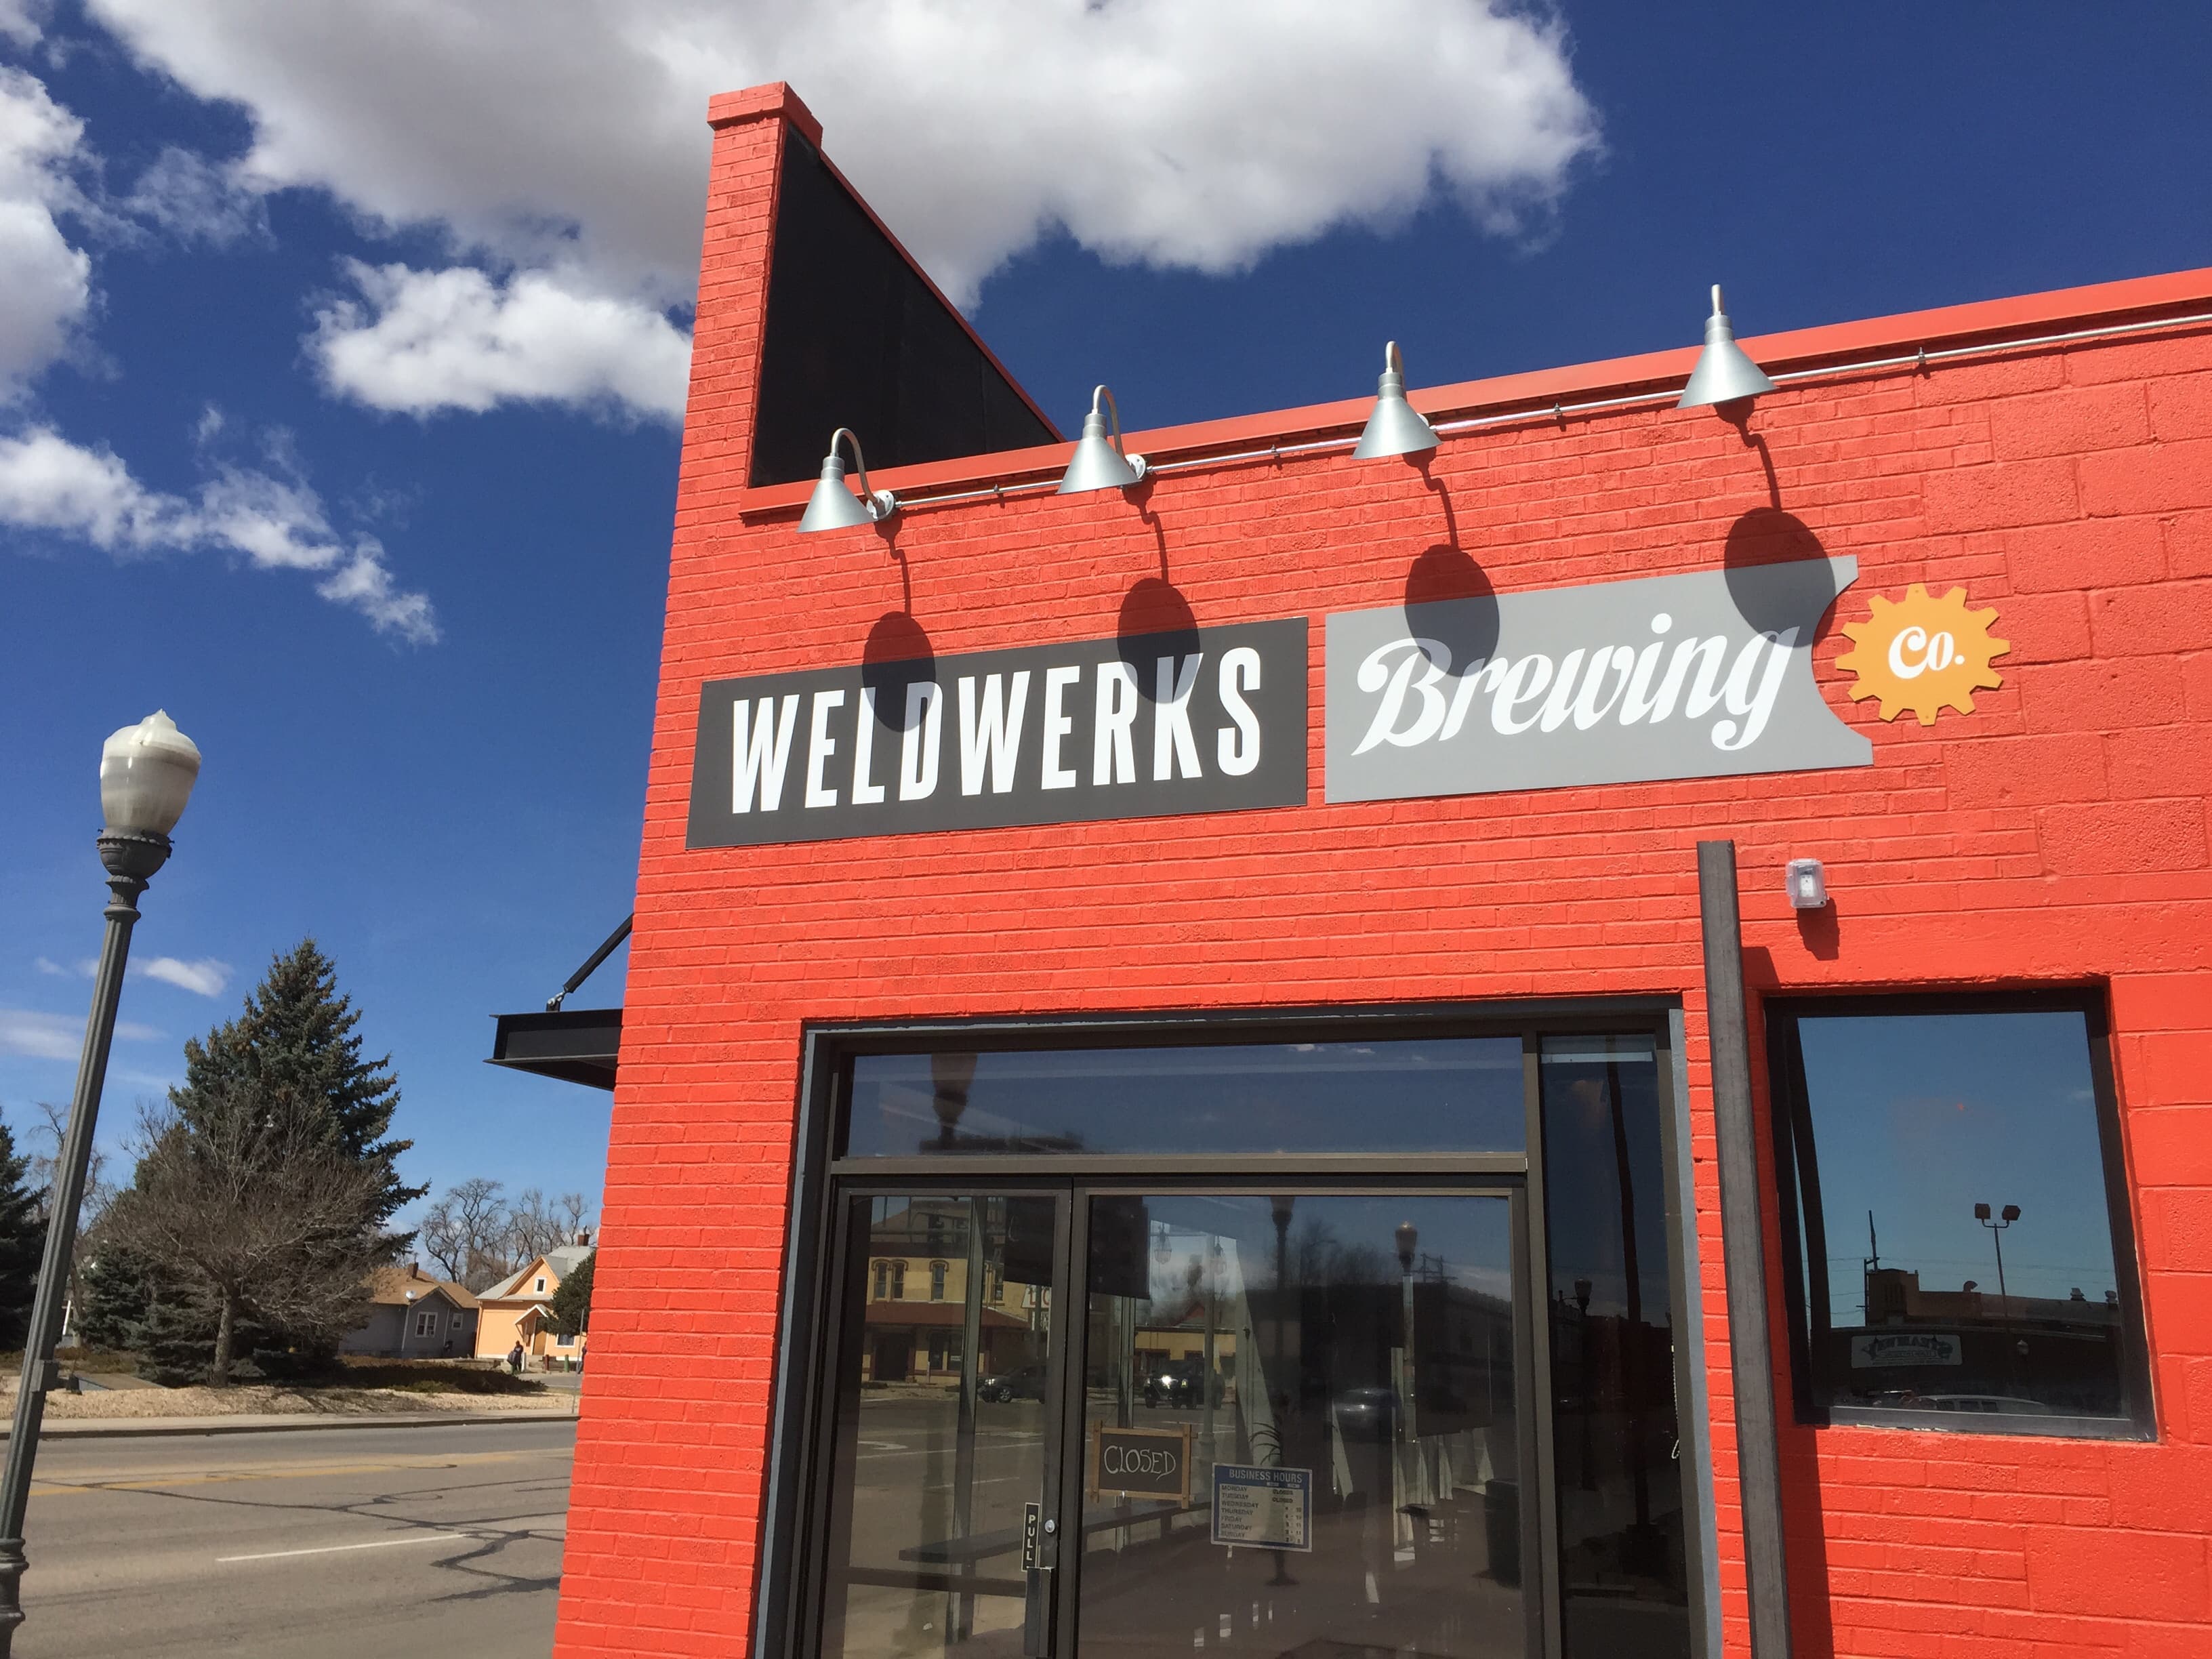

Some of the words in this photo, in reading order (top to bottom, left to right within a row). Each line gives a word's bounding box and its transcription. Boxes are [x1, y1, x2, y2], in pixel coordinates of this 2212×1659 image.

[1887, 625, 1965, 680] Co.
[1351, 613, 1800, 756] Brewing
[732, 647, 1261, 815] WELDWERKS
[1104, 1445, 1176, 1481] CLOSED
[1229, 1469, 1271, 1481] BUSINESS
[1273, 1472, 1303, 1483] HOURS
[1026, 1515, 1036, 1561] PULL
[1221, 1523, 1252, 1531] SATURDAY
